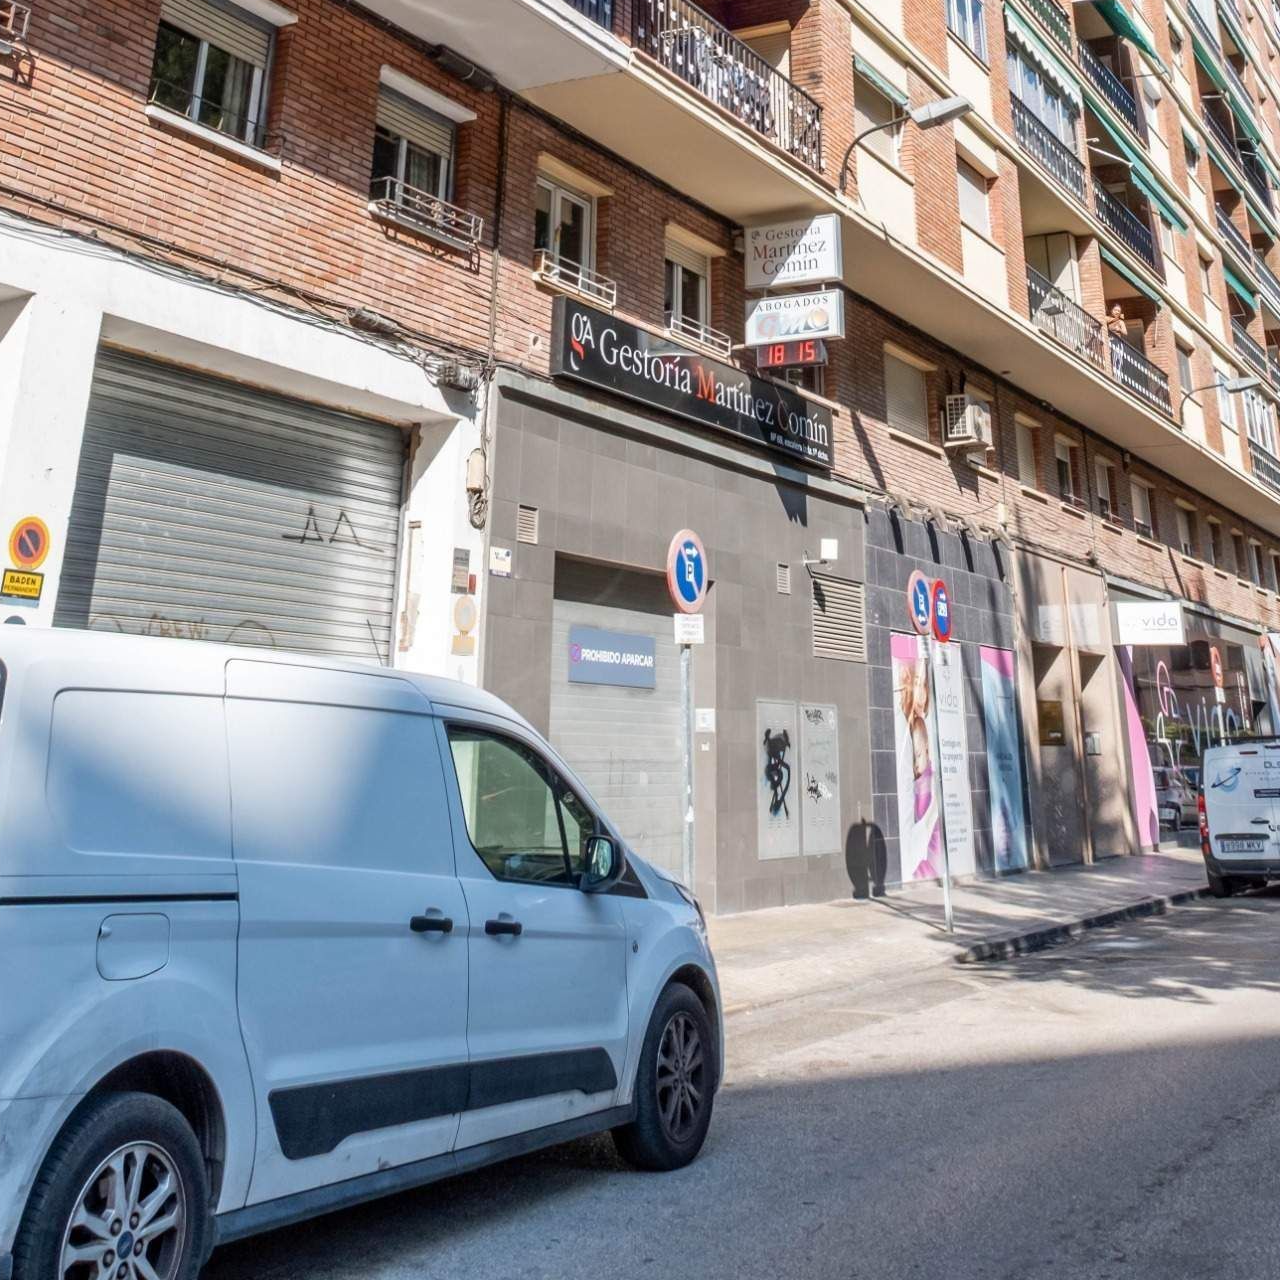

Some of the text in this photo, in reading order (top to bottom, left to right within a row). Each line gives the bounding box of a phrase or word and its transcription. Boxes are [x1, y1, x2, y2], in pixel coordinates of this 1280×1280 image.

[753, 239, 827, 261] Martínez
[762, 255, 818, 275] Comín
[756, 295, 830, 313] ABOGADOS
[768, 340, 816, 366] 18 15
[599, 328, 693, 396] Gestoría
[695, 367, 775, 426] Martínez
[777, 399, 829, 447] Comín
[9, 575, 37, 586] BADEN
[1142, 611, 1178, 626] vida
[581, 648, 654, 667] PROHIBIDO APARCAR
